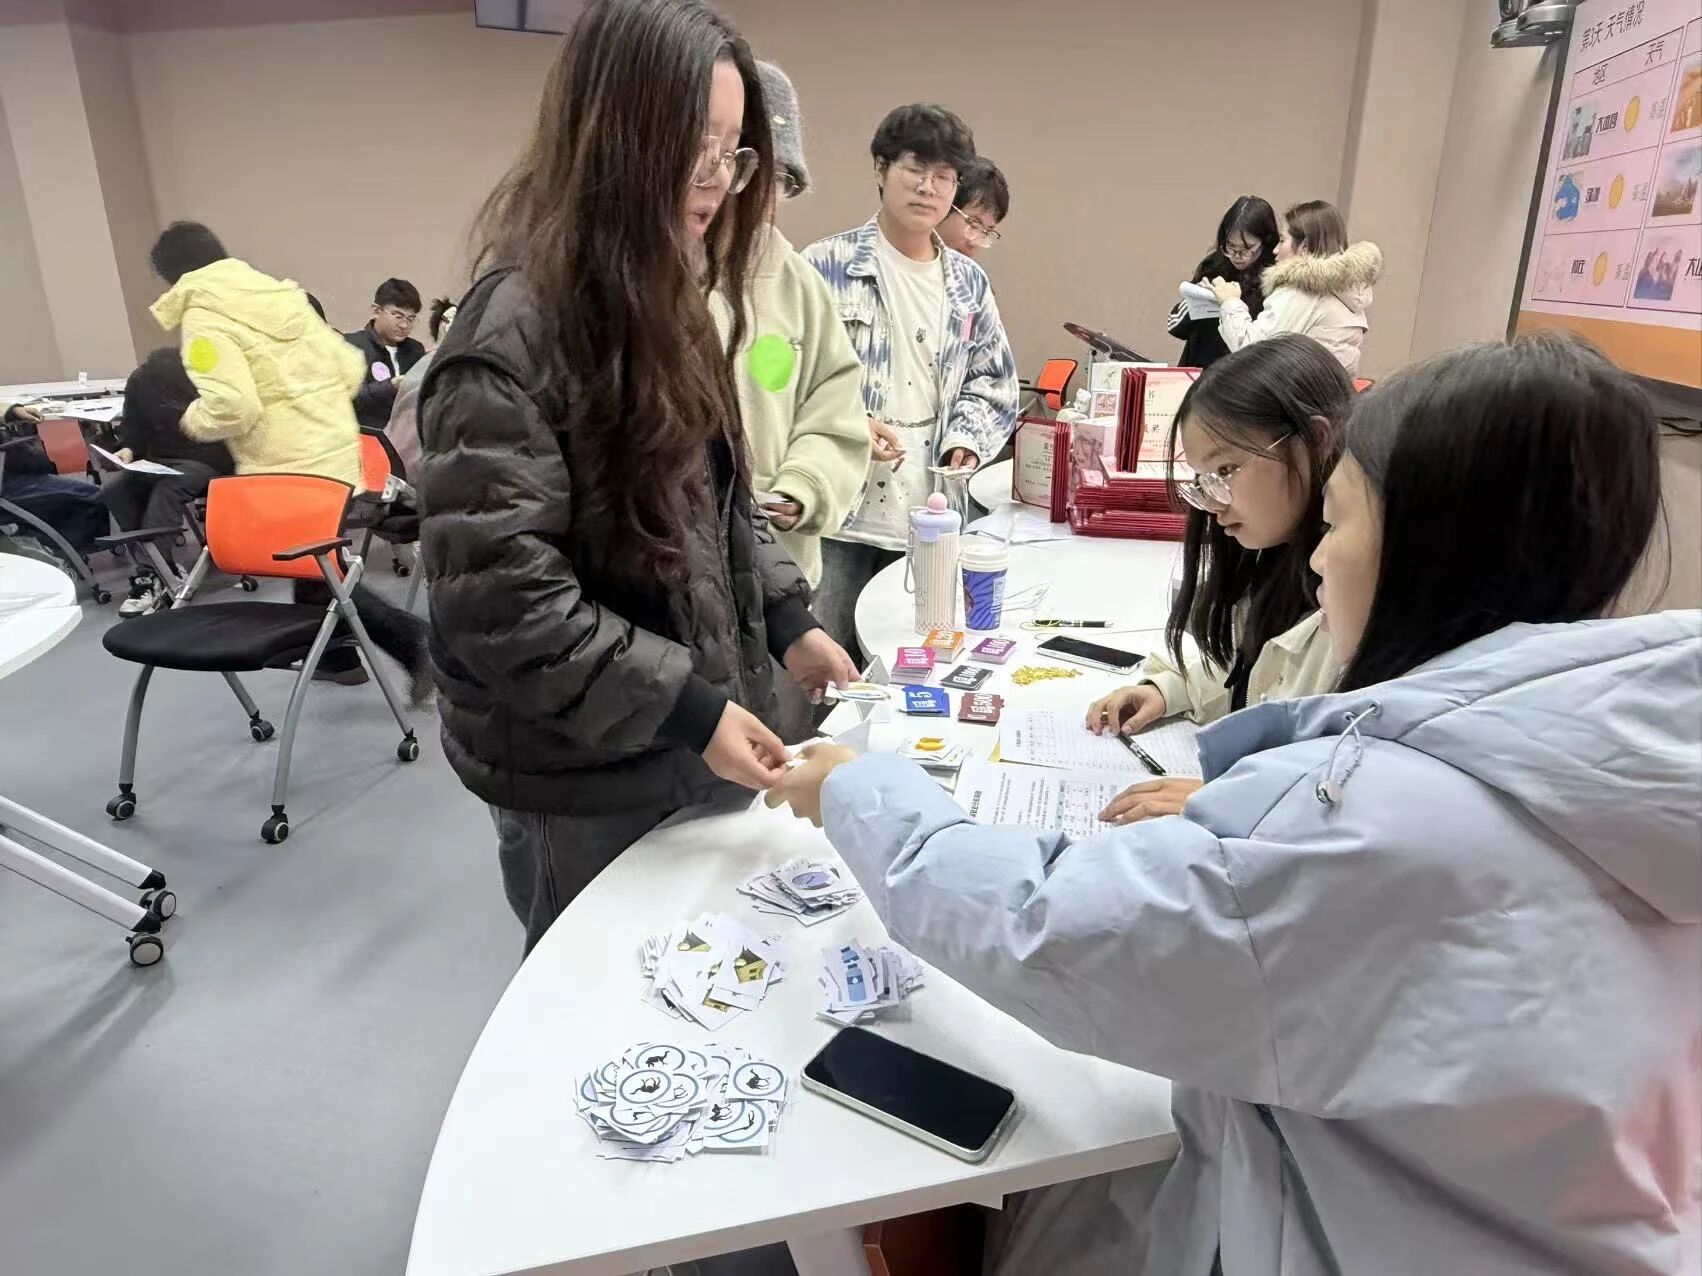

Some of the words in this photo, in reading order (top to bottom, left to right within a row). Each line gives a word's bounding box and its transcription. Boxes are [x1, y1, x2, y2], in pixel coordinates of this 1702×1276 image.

[1604, 0, 1646, 41] 天气情况
[1644, 40, 1665, 66] 天气
[903, 648, 927, 658] 10
[907, 691, 933, 699] 5
